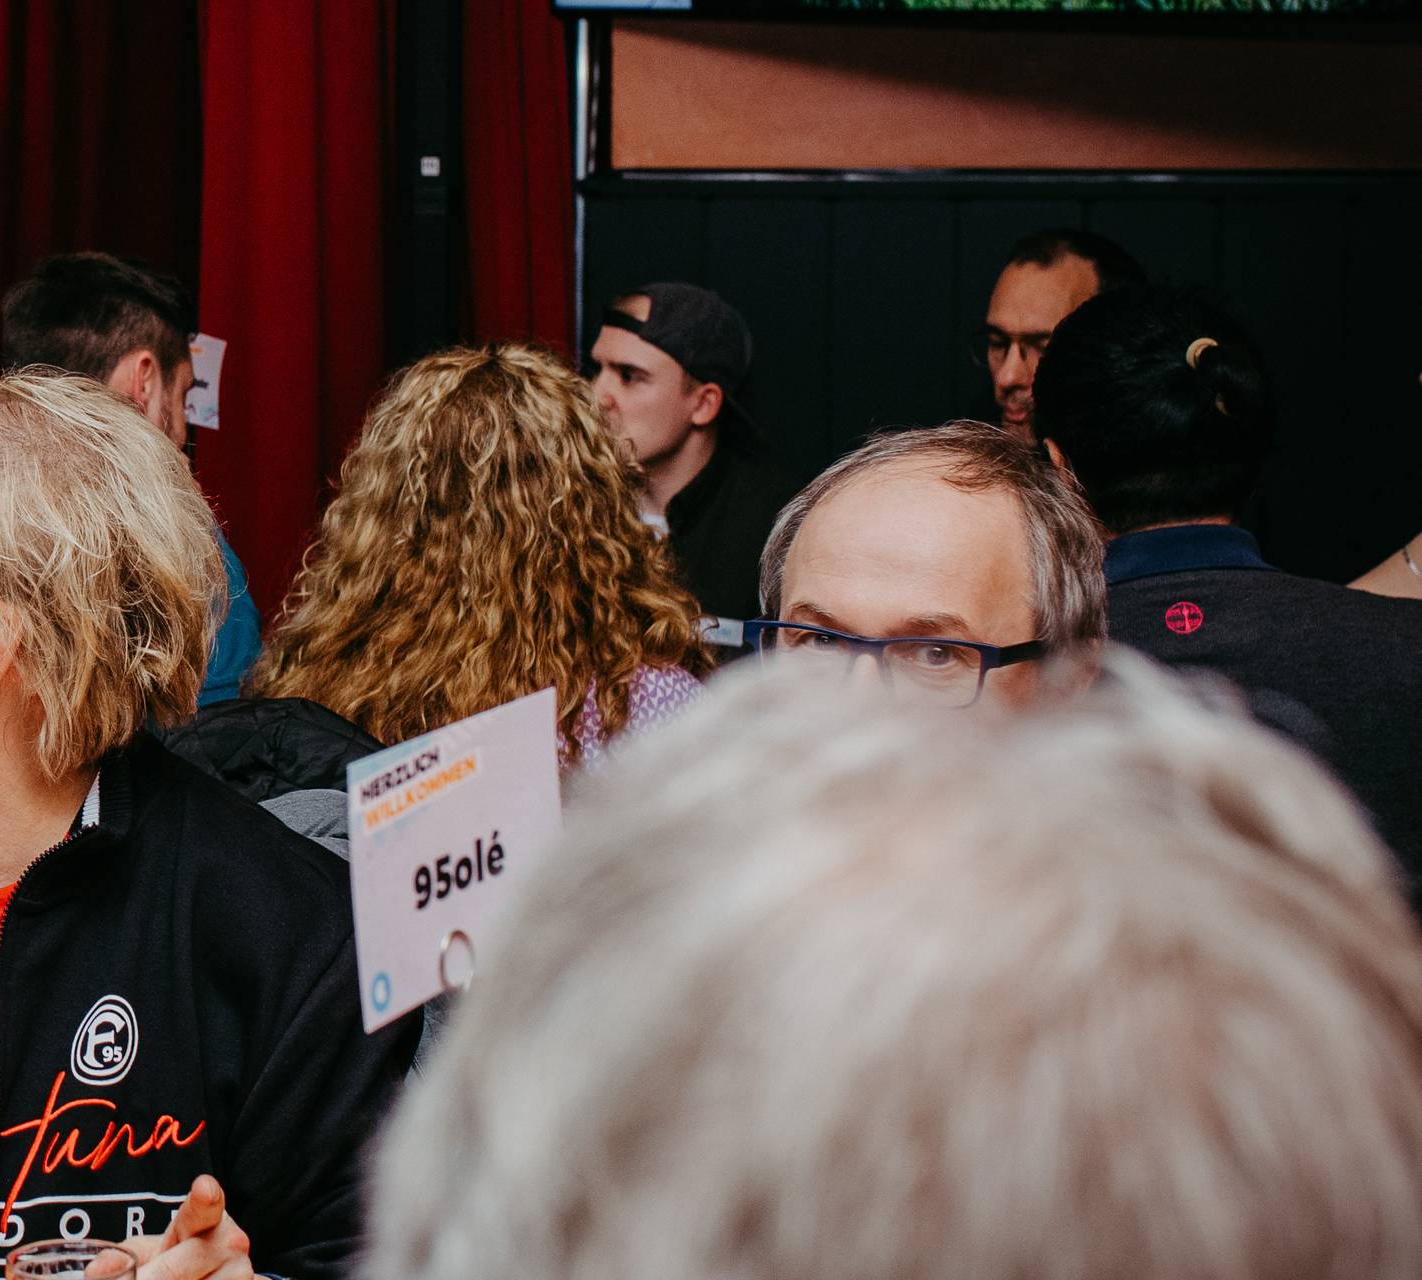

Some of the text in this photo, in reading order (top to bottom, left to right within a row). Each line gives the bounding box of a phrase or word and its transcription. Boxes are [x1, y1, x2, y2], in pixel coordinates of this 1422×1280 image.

[361, 747, 440, 802] HERZLICH
[364, 755, 476, 828] WILLKOMMEN
[415, 829, 505, 909] 95olé
